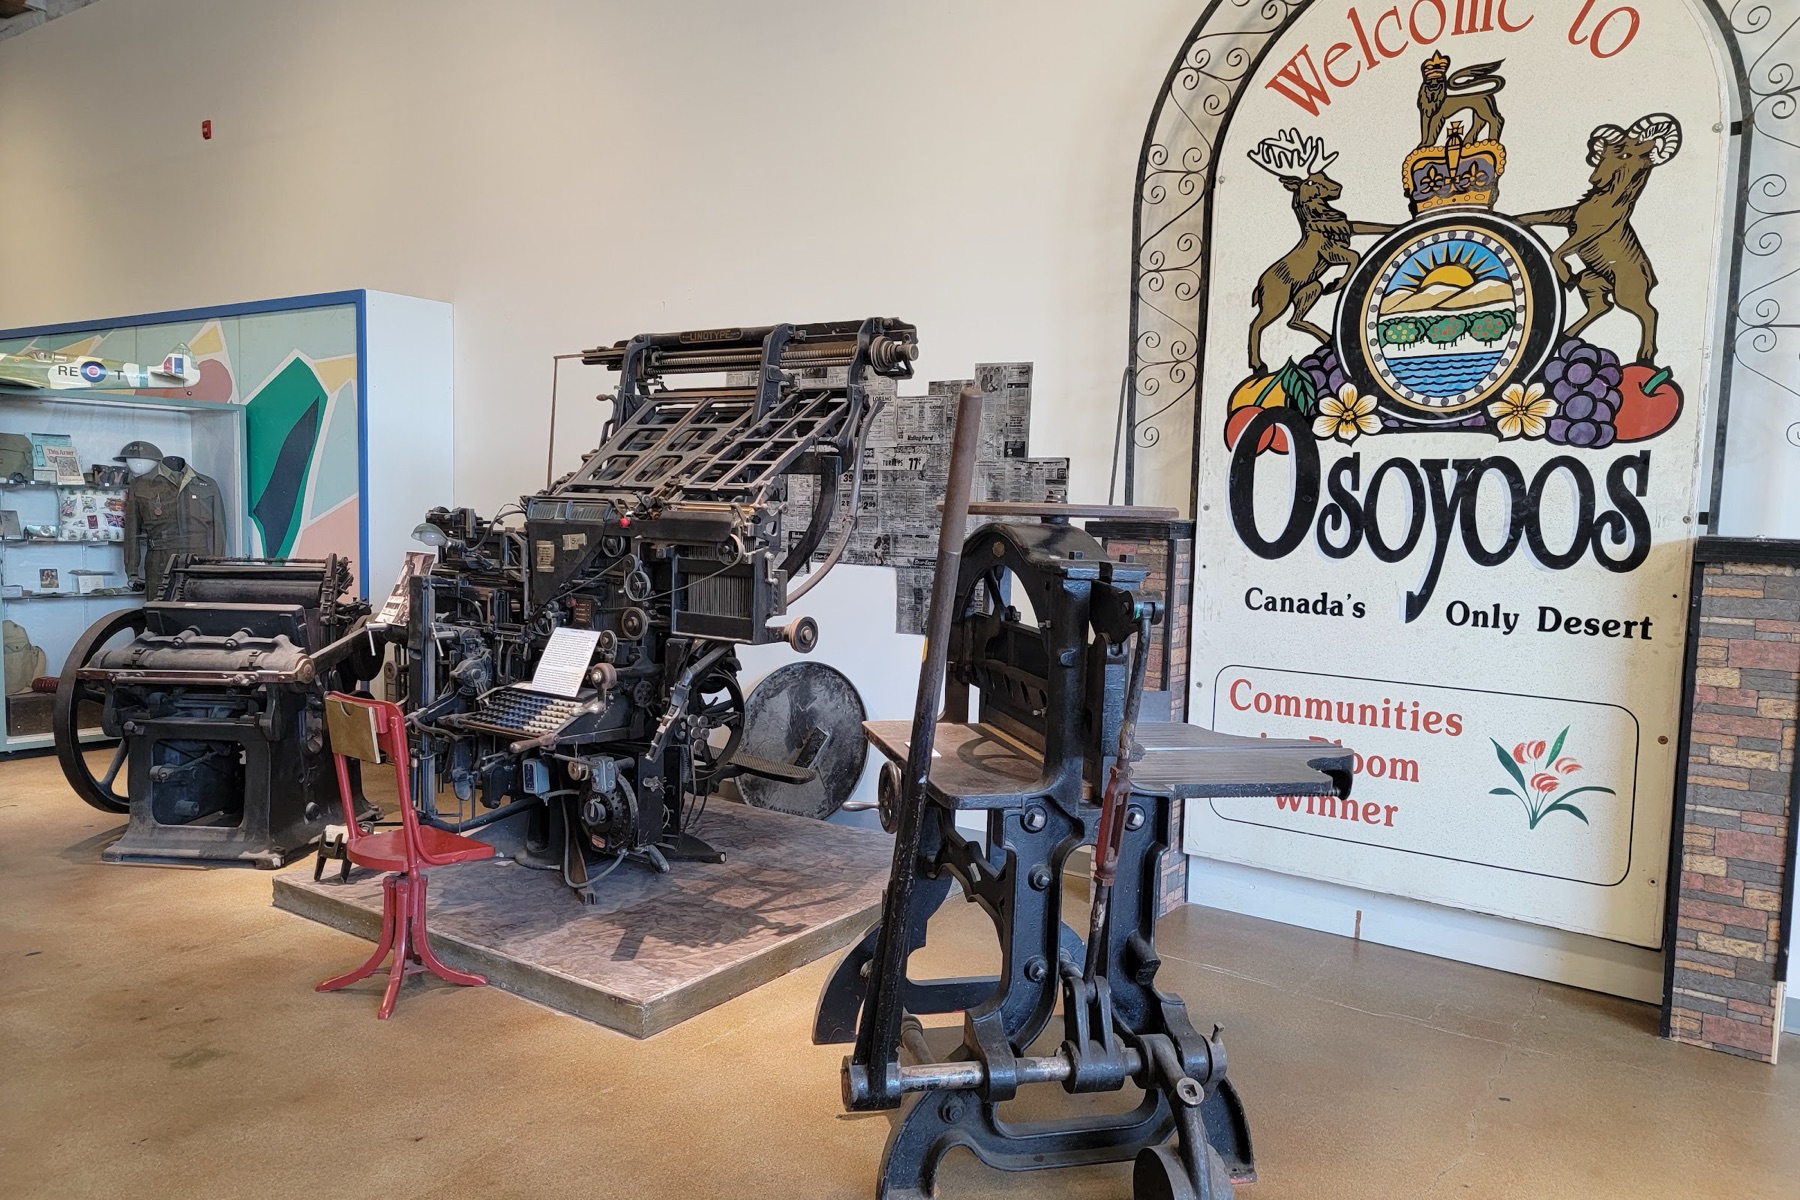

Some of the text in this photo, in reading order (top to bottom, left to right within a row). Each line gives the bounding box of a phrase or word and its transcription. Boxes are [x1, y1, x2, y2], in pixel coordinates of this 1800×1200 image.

[1264, 0, 1535, 117] Welcome
[690, 330, 731, 341] LINOTYPE
[58, 366, 78, 377] RE
[1230, 406, 1652, 623] Osoyoos
[1245, 587, 1654, 641] Canada's Only Desert
[1230, 679, 1463, 737] Communities
